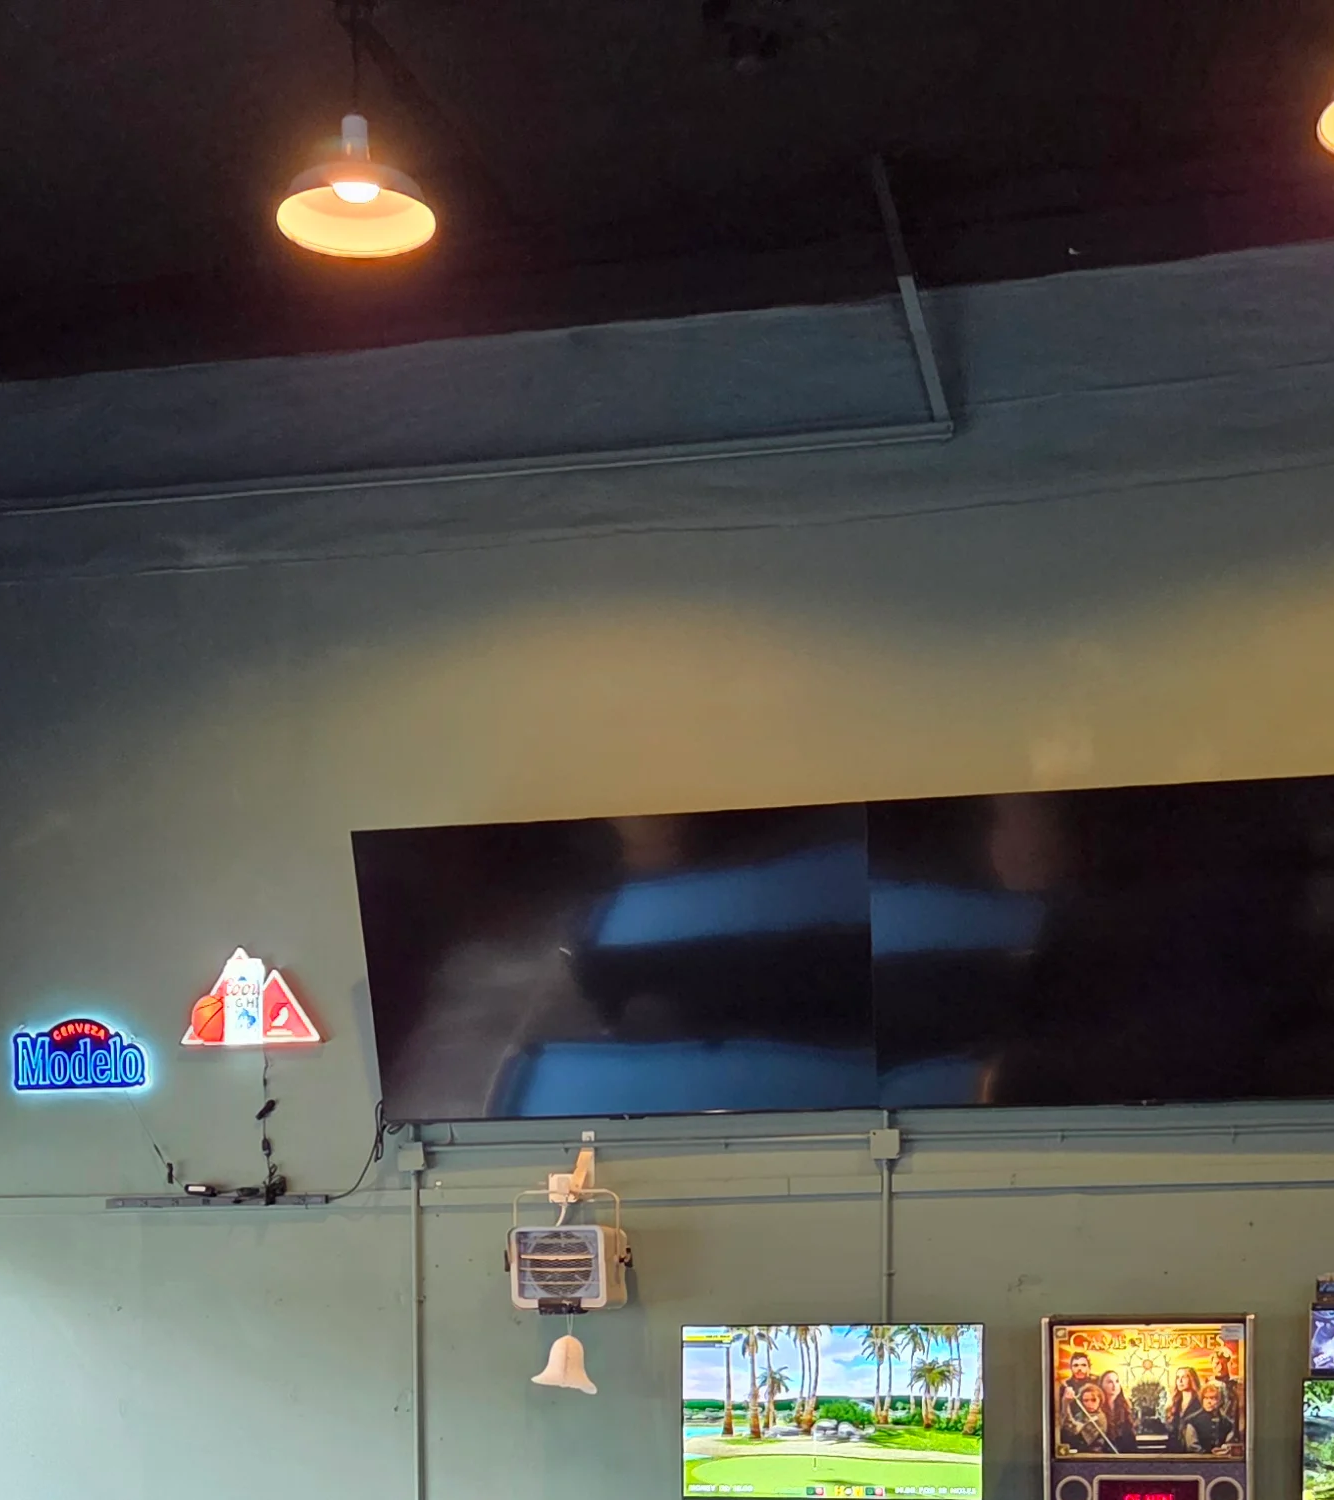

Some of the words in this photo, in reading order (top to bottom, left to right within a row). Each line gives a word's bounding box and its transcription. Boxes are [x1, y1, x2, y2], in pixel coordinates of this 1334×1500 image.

[52, 1022, 105, 1041] CERVEZA
[17, 1036, 143, 1085] Modelo
[1139, 1331, 1225, 1352] THRONES
